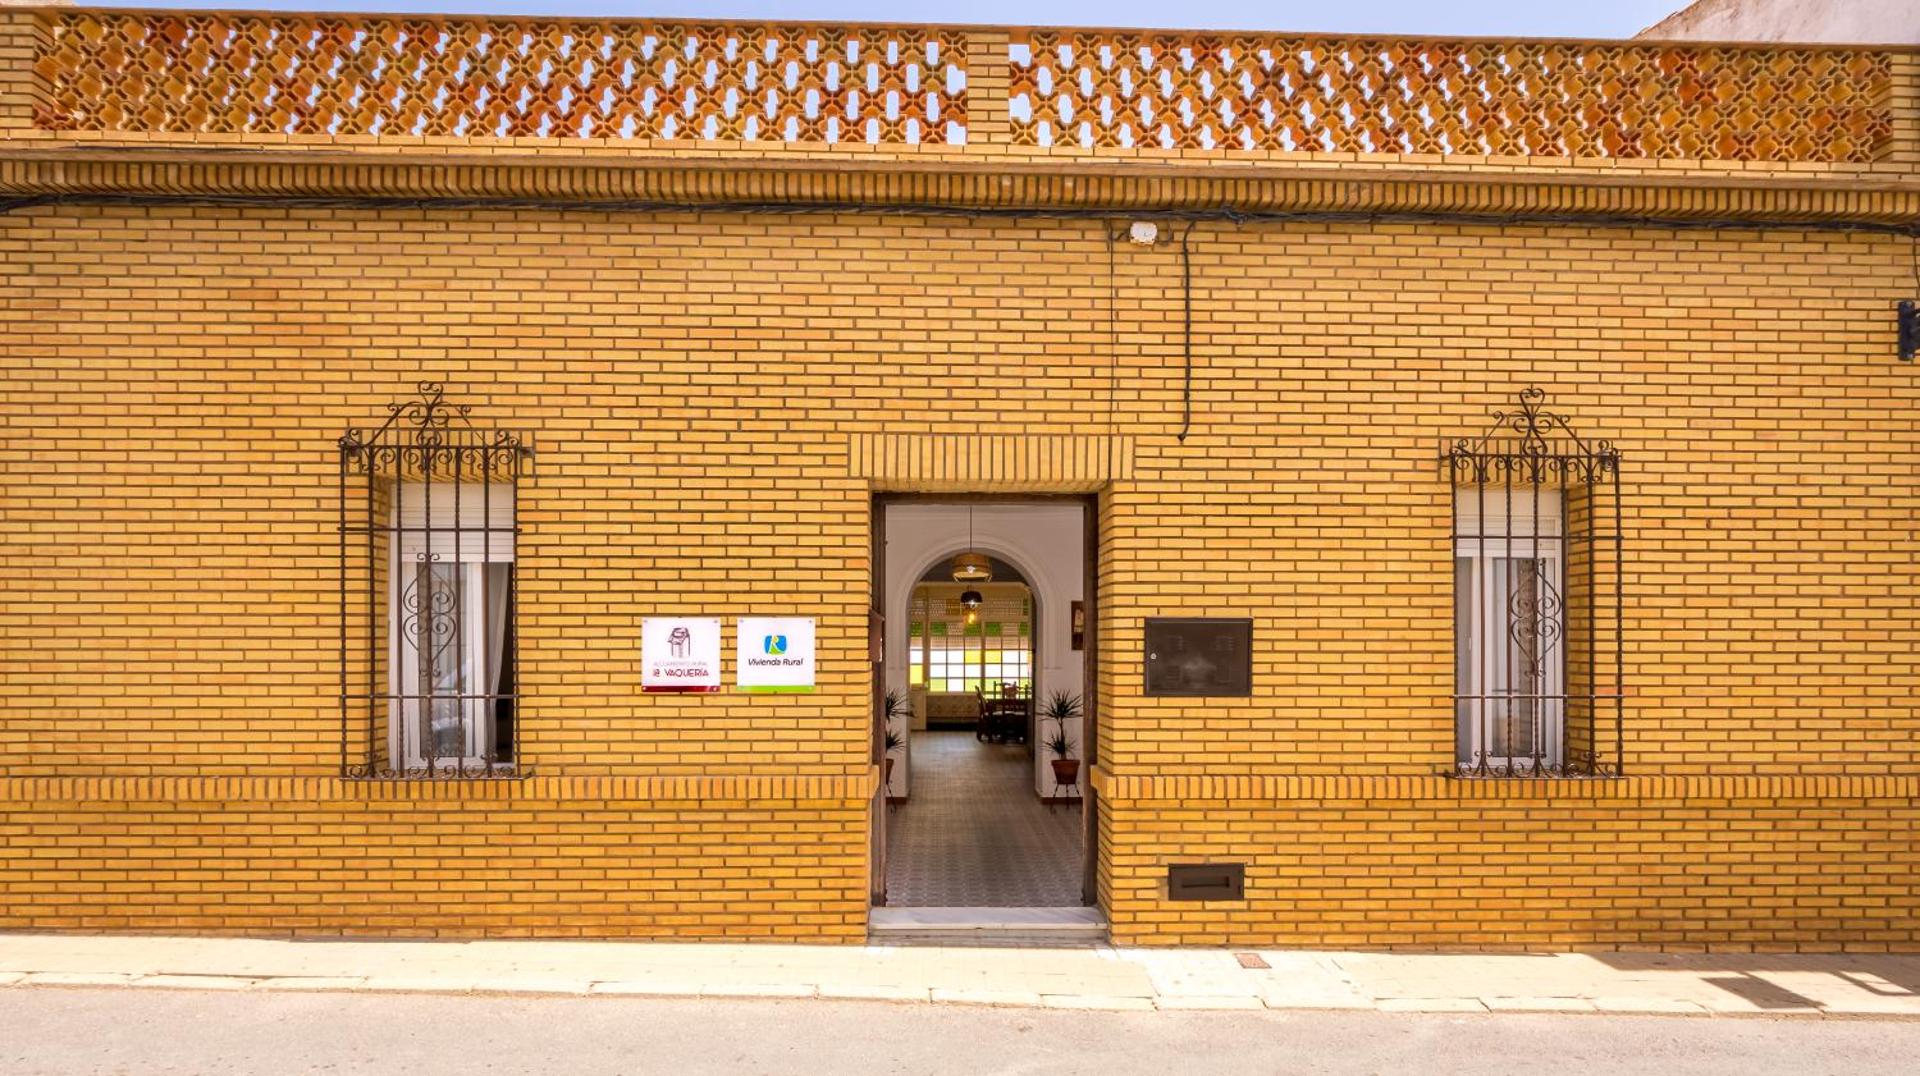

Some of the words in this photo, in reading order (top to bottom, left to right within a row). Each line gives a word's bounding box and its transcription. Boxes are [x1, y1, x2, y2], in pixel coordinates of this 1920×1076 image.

[748, 658, 781, 666] Vivienda
[783, 658, 803, 666] Rural
[664, 667, 709, 678] VAQUERÍA
